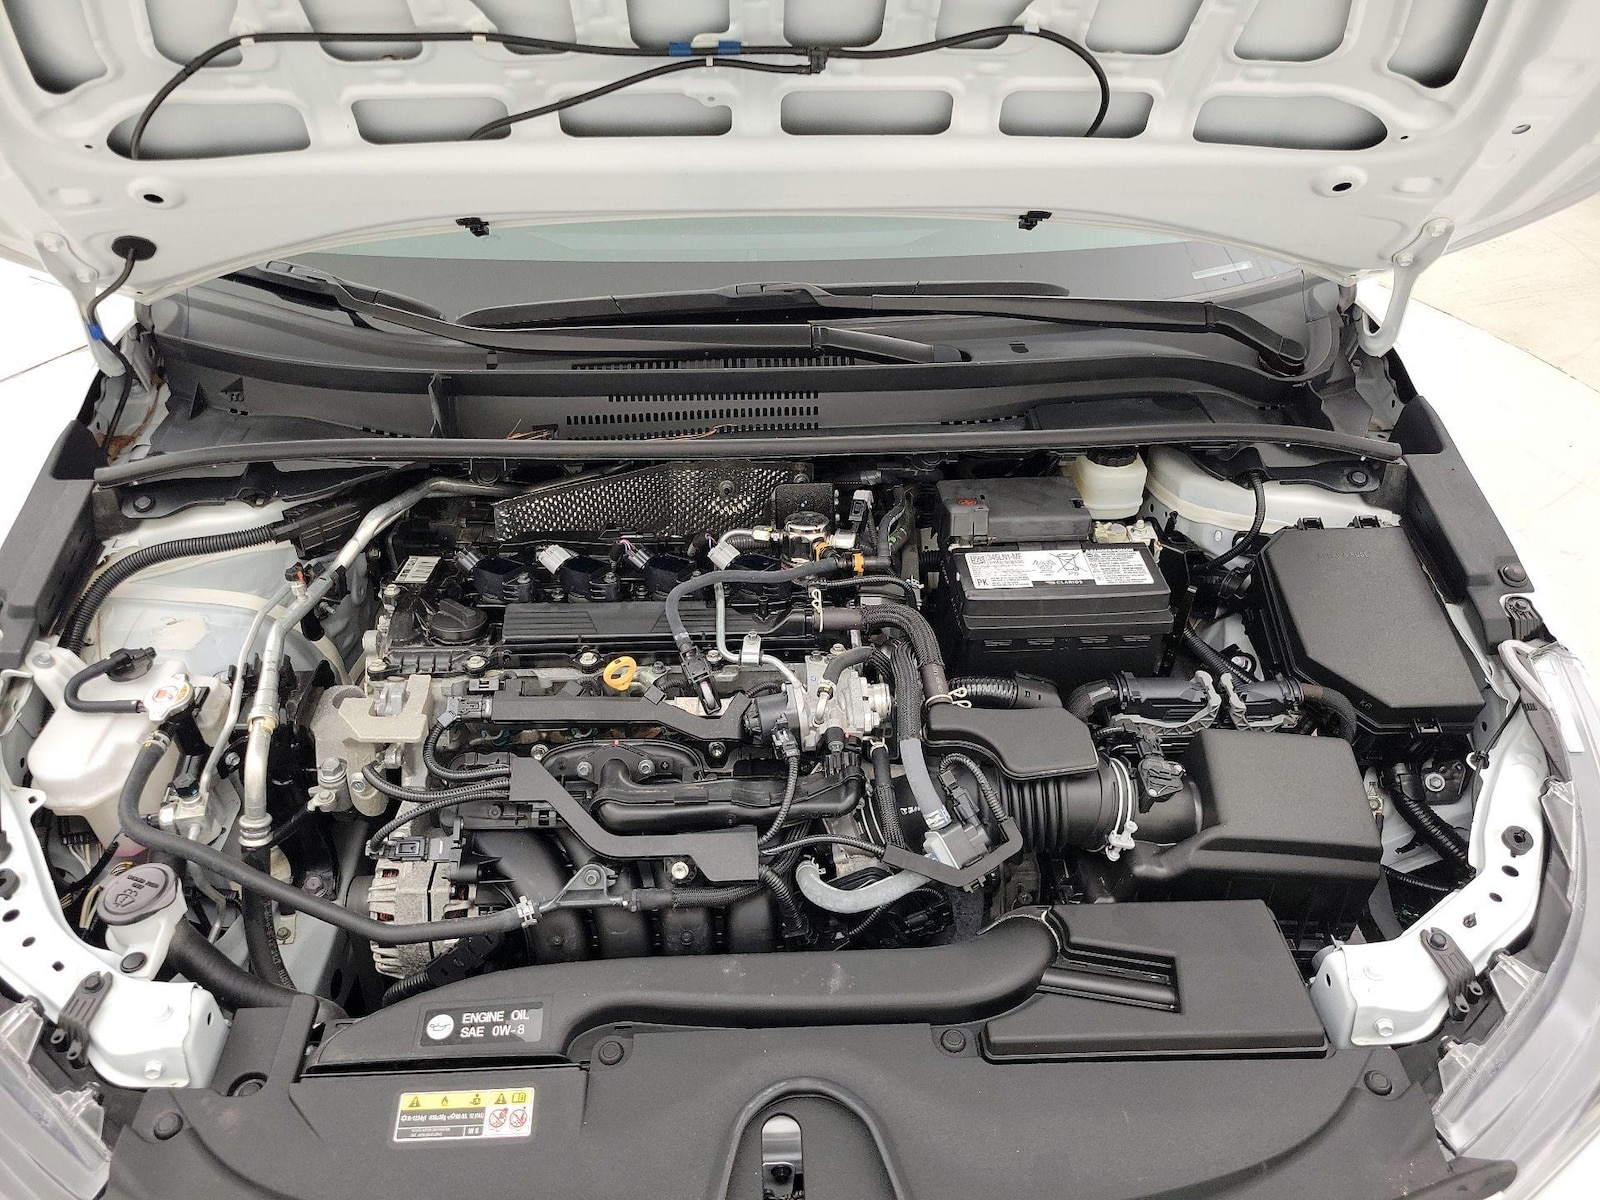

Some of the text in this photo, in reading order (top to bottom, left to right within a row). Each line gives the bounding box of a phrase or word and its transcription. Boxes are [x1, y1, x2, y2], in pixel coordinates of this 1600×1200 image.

[462, 1009, 529, 1024] ENGINE OIL
[460, 1024, 525, 1038] SAE 0W-8
